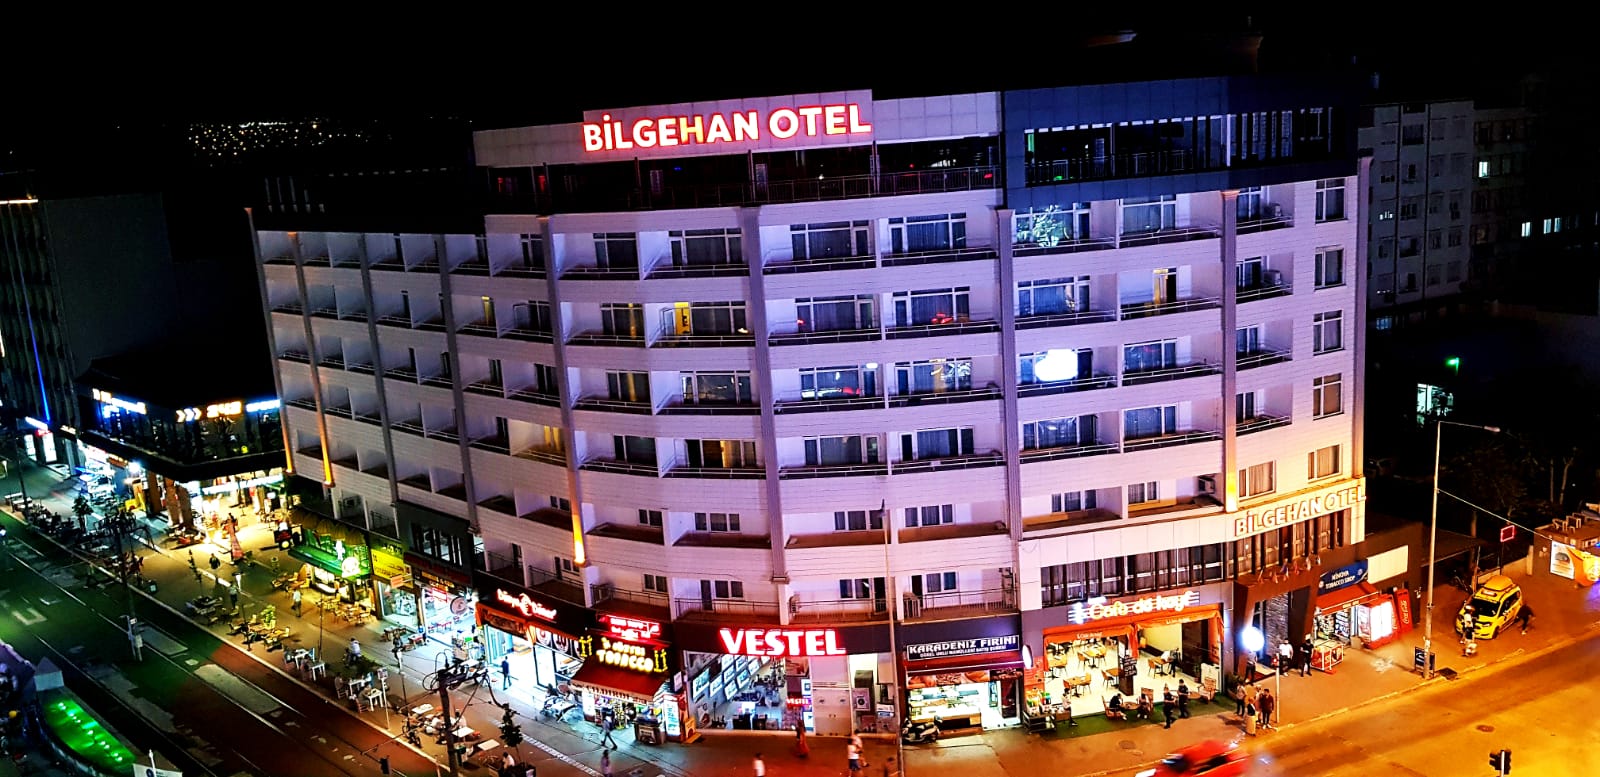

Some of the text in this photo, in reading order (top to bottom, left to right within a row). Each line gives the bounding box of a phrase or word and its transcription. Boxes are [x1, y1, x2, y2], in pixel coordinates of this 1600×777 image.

[583, 104, 872, 152] BİLGEHAN OTEL
[1235, 485, 1366, 537] BİLGEHAN OTEL
[596, 650, 653, 672] TOBACCO
[719, 628, 847, 656] VESTEL
